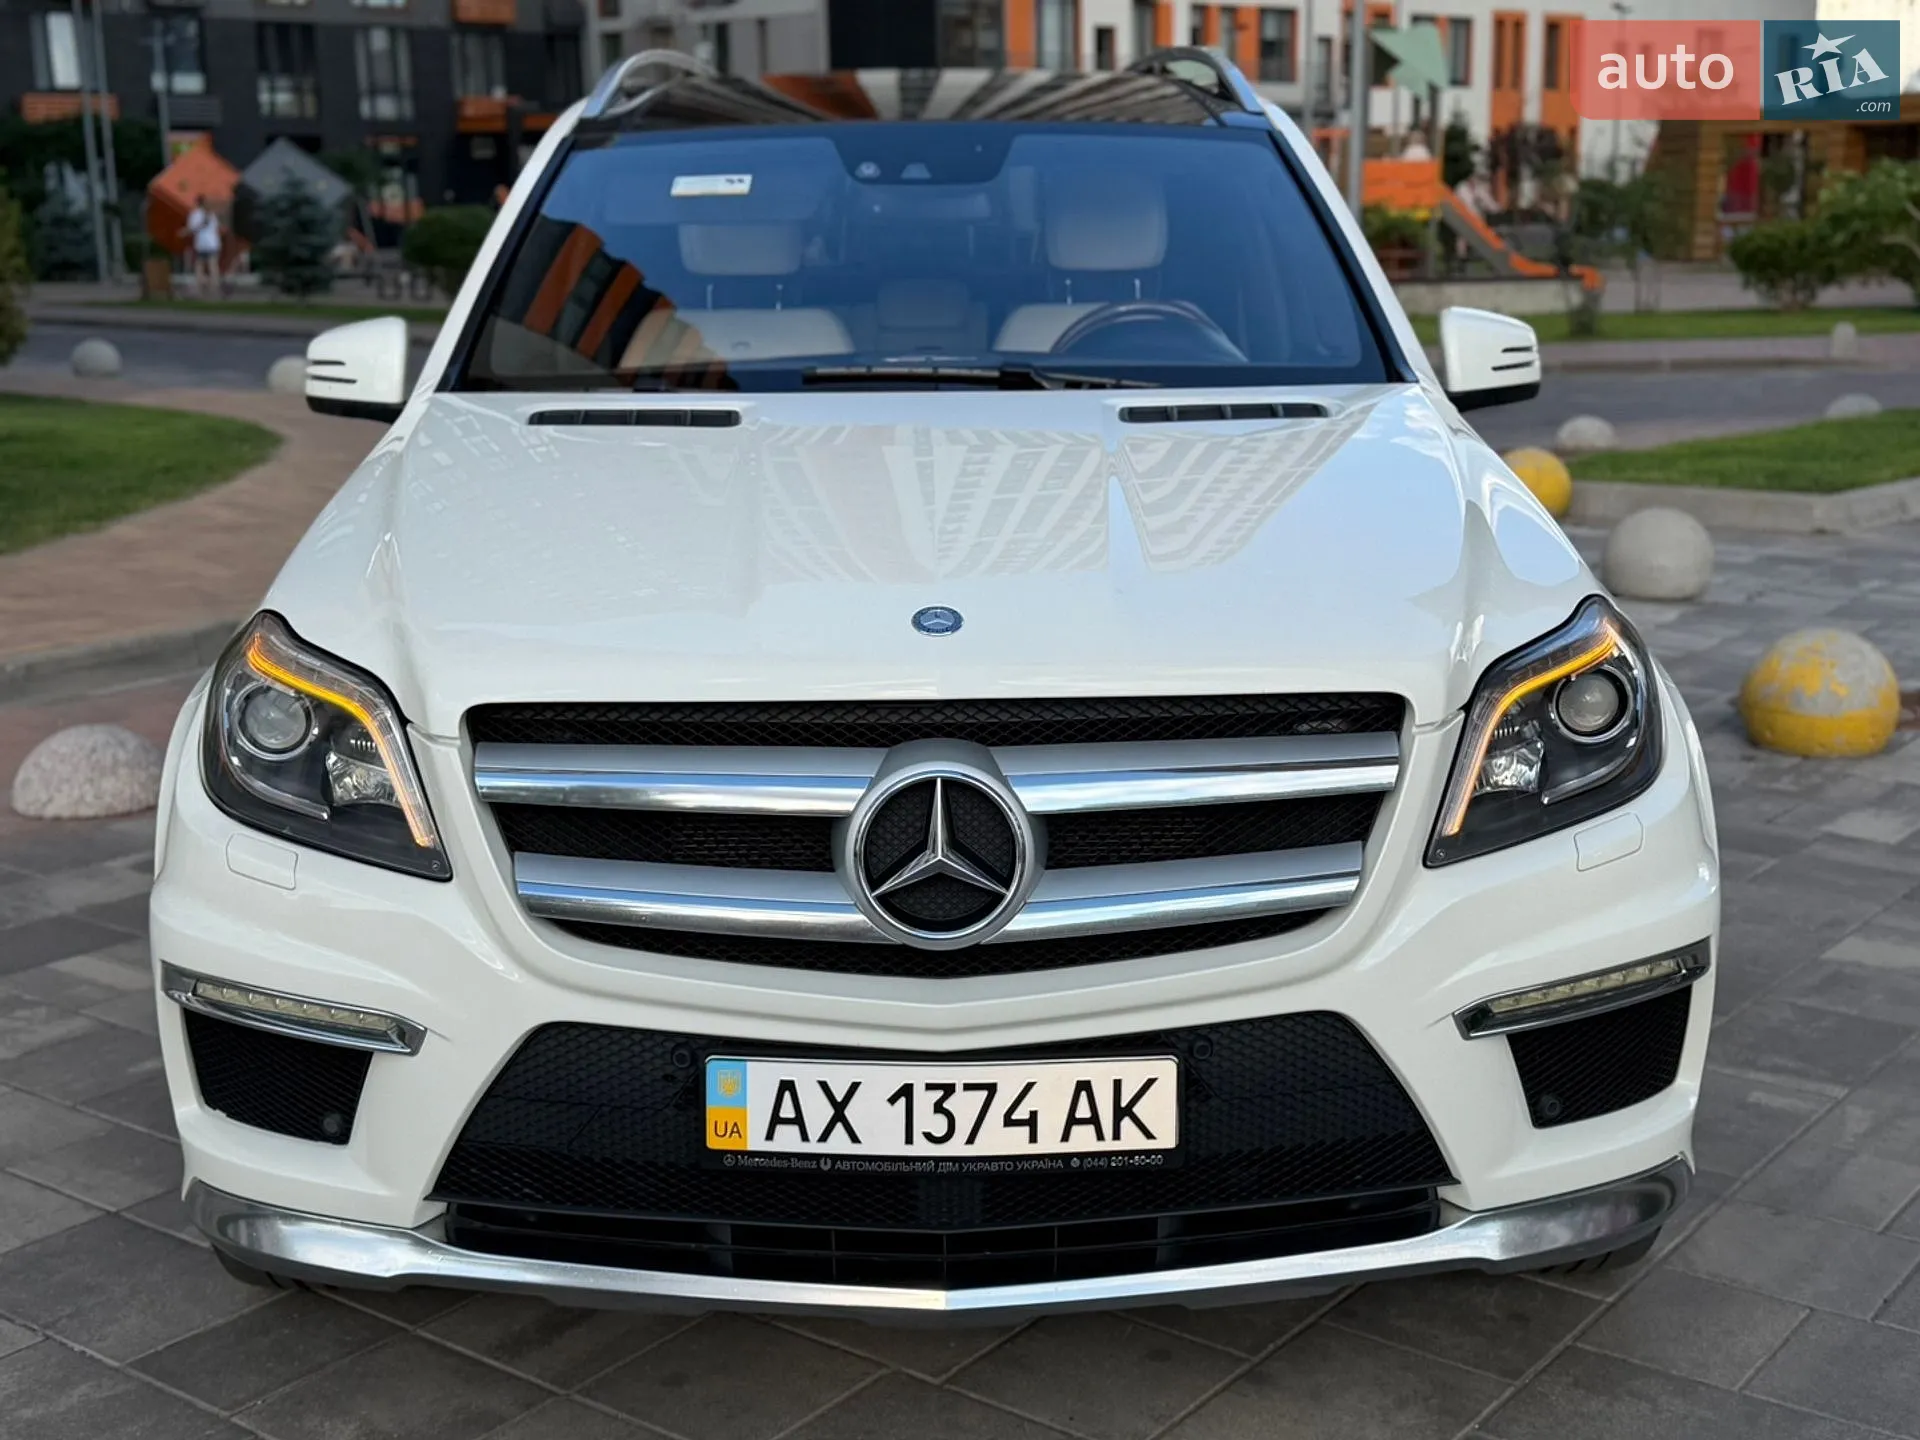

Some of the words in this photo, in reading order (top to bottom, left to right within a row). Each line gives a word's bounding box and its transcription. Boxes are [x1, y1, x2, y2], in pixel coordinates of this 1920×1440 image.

[764, 1079, 863, 1145] AX
[887, 1081, 1039, 1146] 1374
[1060, 1077, 1159, 1143] AK
[714, 1120, 742, 1139] UA
[737, 1155, 817, 1168] Mercedes-Benz
[835, 1159, 935, 1172] АВТОМОБІЛЬНИЙ
[937, 1161, 960, 1173] ДІМ
[962, 1160, 1014, 1172] УКРАВТО
[1016, 1157, 1064, 1170] УКРАЇНА
